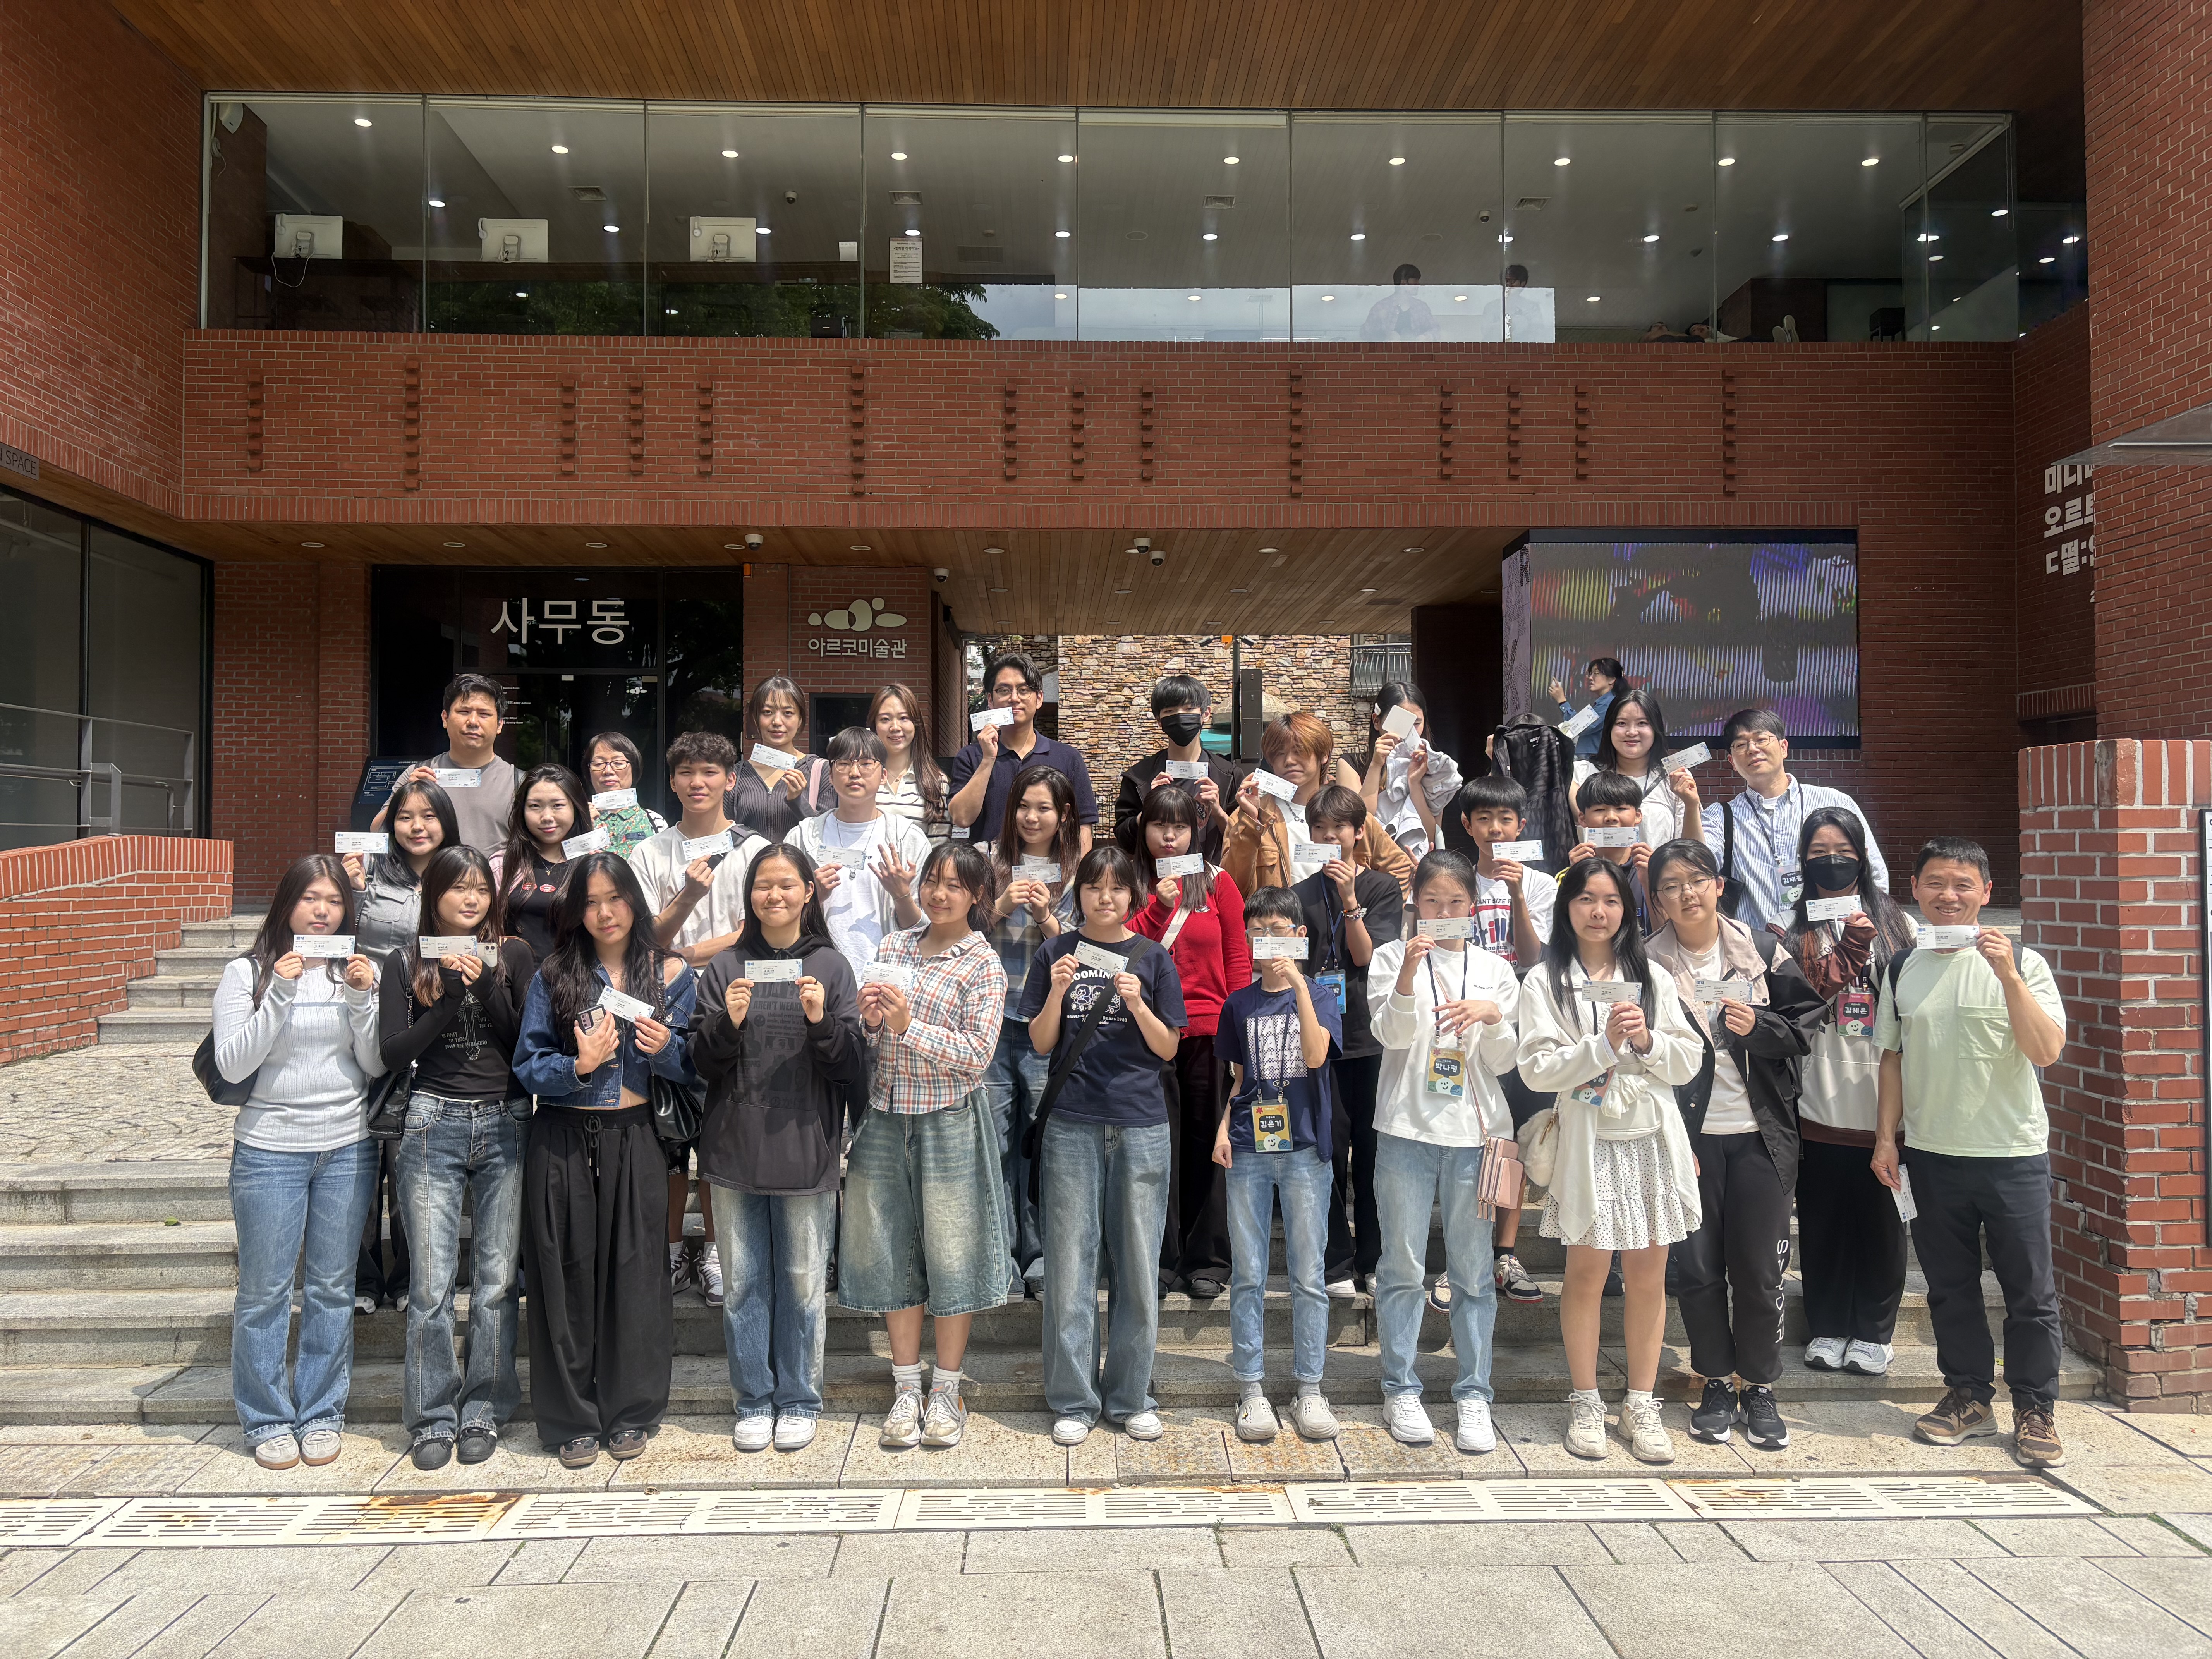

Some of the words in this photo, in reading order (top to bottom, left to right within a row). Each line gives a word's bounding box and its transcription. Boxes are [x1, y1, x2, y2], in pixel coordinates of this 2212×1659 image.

[6, 450, 36, 476] SPACE
[2045, 465, 2093, 495] 미니
[490, 598, 630, 644] 사무동
[808, 638, 907, 658] 아르코미술관
[1071, 969, 1114, 982] OOMIN
[1435, 1062, 1458, 1072] 박나령
[1260, 1120, 1282, 1128] 김은기
